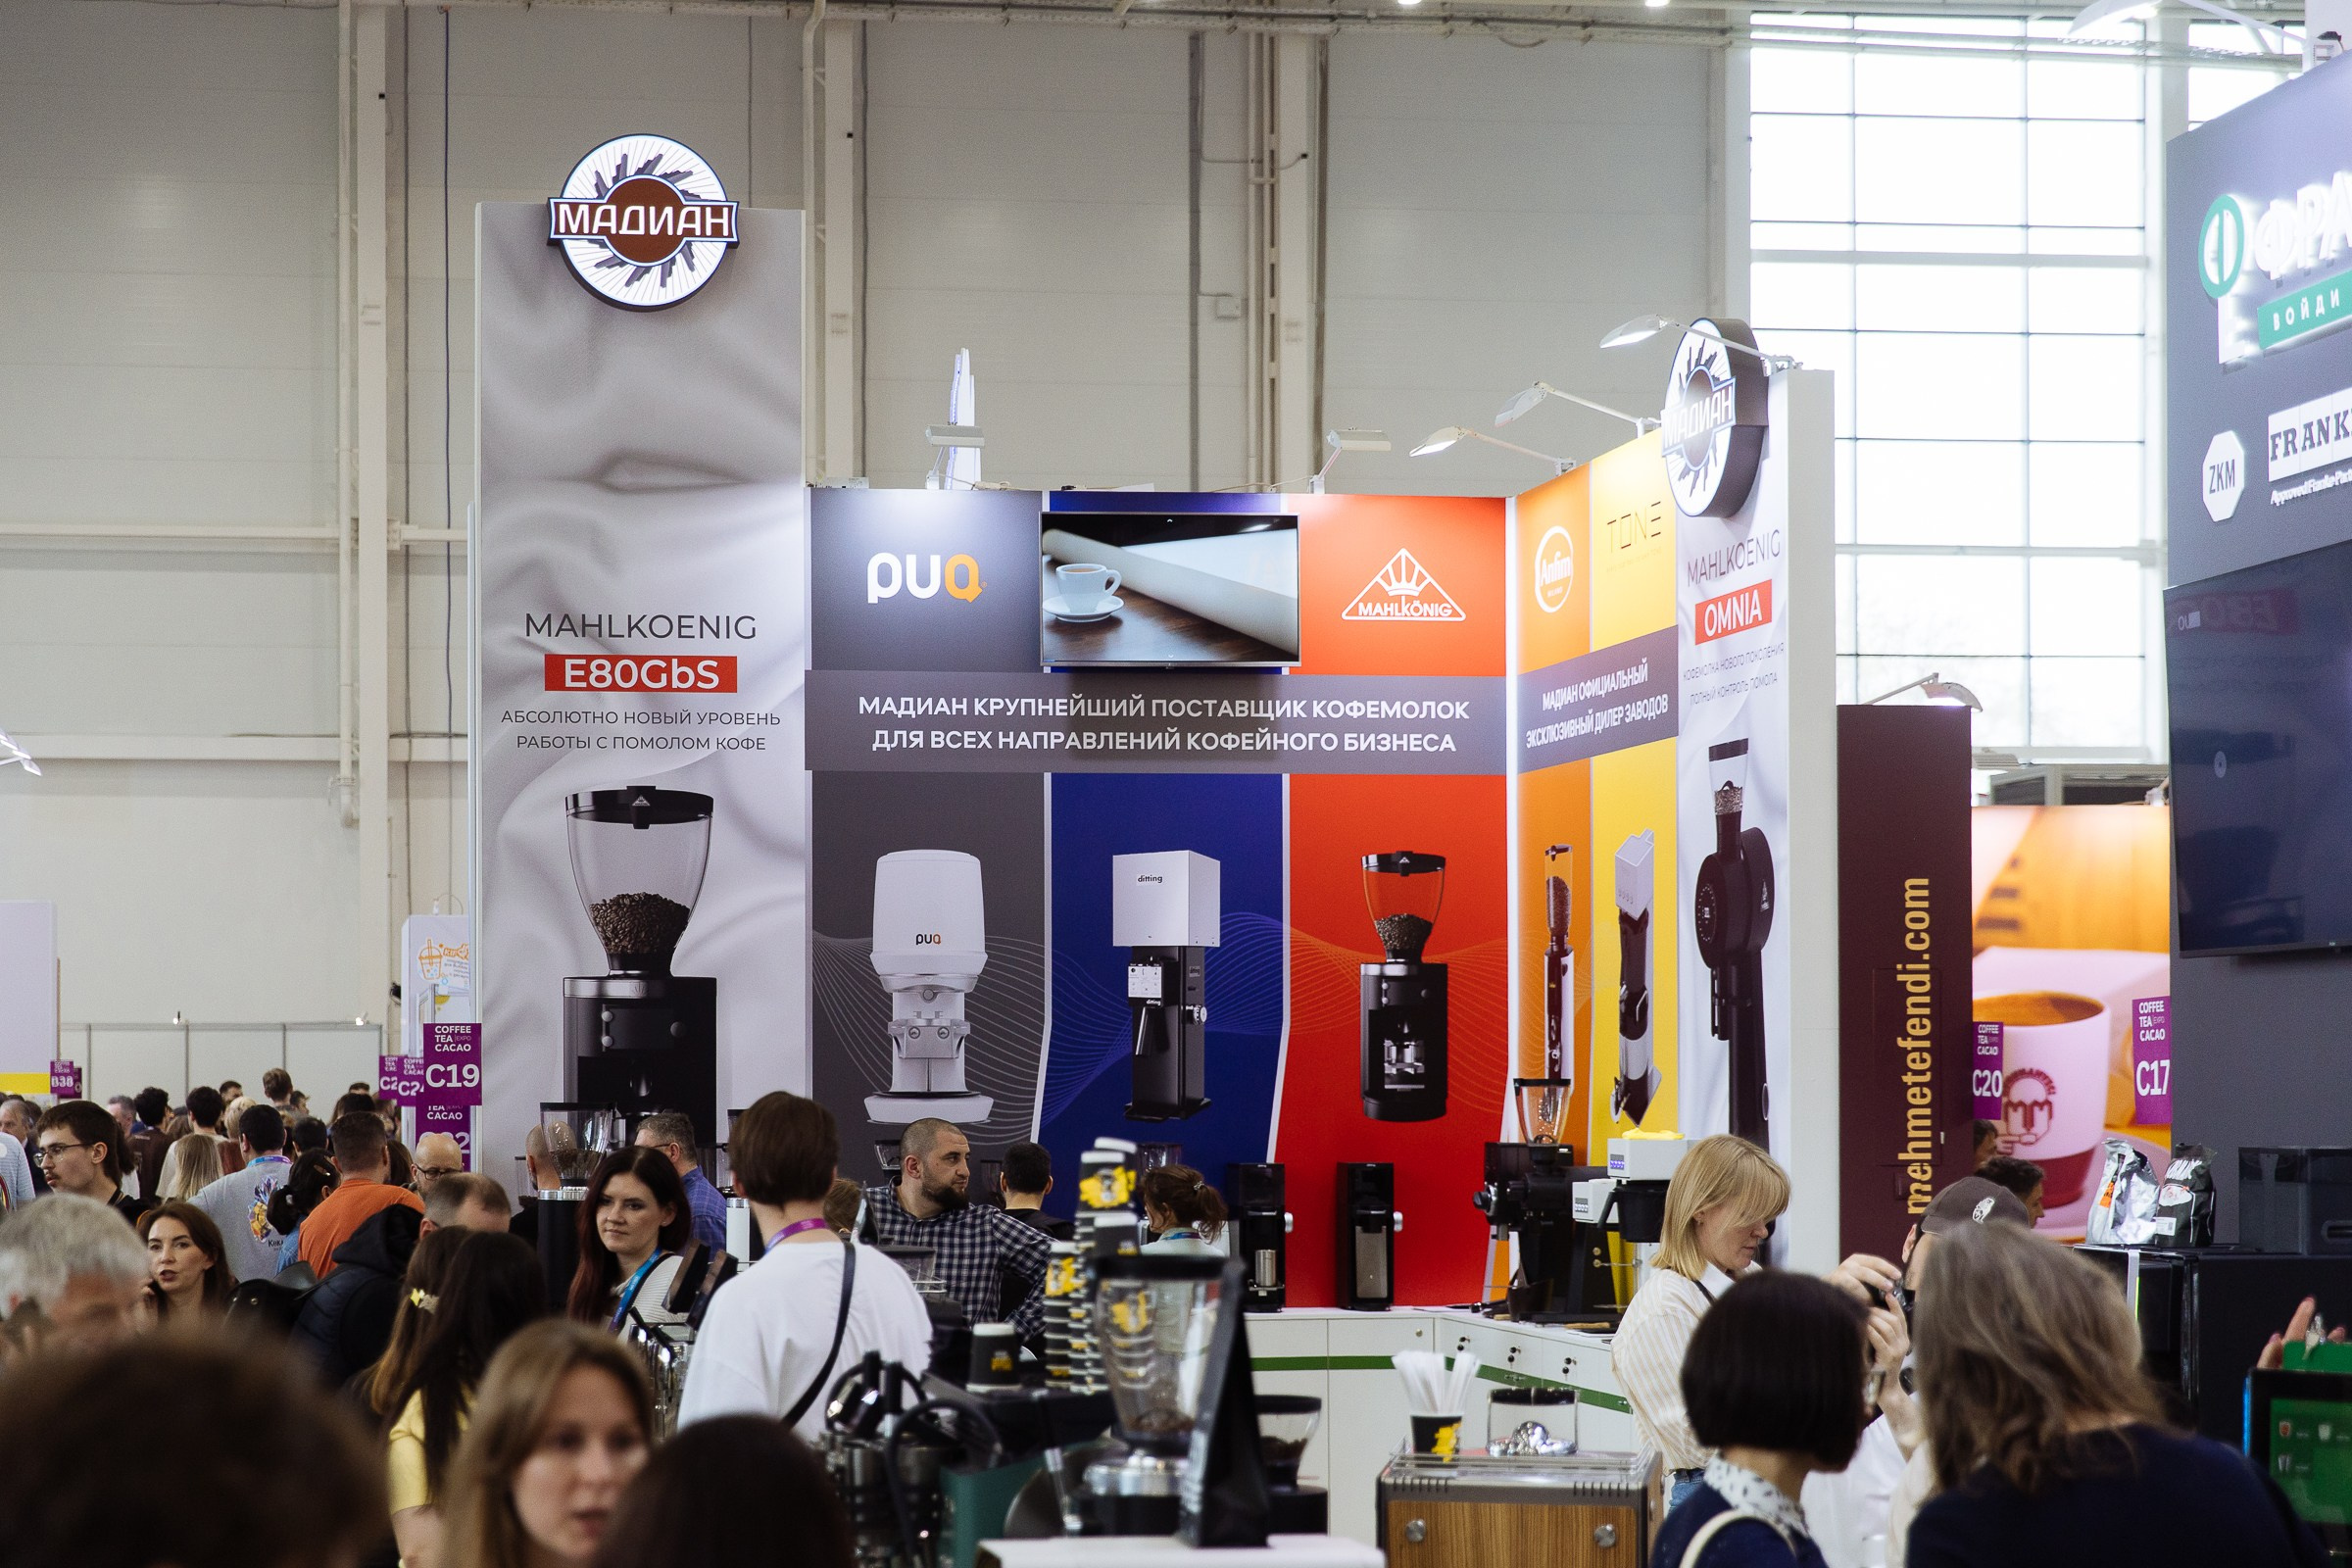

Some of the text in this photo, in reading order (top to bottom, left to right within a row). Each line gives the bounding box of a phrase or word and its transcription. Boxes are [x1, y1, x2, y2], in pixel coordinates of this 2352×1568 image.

[559, 204, 729, 236] МАДИАН
[2273, 288, 2340, 331] ВОЙДИ
[1664, 385, 1733, 447] МАДИАН
[2270, 408, 2352, 463] FRANK
[2209, 459, 2235, 495] ZKM
[2271, 479, 2309, 506] Approved
[2308, 474, 2335, 494] Franke
[1607, 501, 1661, 553] TONE
[1540, 551, 1571, 587] Anfim
[1688, 529, 1781, 587] MAHLKOENIG
[1358, 597, 1453, 616] MAHLKÖNIG
[1704, 590, 1763, 637] OMNIA
[525, 612, 757, 639] MAHLKOENIG
[564, 658, 719, 689] E80GbS
[1543, 657, 1648, 711] МАДИАН ОФИЦИАЛЬНЫЙ
[501, 709, 781, 726] АБСОЛЮТНО НОВЫЙ УРОВЕНЬ
[859, 694, 1470, 720] МАДИАН КРУПНЕЙШИЙ ПОСТАВЩИК КОФЕМОЛОК
[1526, 694, 1669, 749] ЭКСКЛЮЗИВНЫЙ ДИЛЕР ЗАВОДОВ
[516, 735, 766, 751] РАБОТЫ С ПОМОЛОМ КОФЕ
[872, 727, 1457, 753] ДЛЯ ВСЕХ НАПРАВЛЕНИЙ КОФЕЙНОГО БИЗНЕСА
[1138, 874, 1163, 884] ditting
[2138, 1001, 2165, 1013] COFFEE
[435, 1025, 471, 1034] COFFEE
[1978, 1024, 1999, 1034] COFFEE
[2138, 1015, 2152, 1028] TEA
[2139, 1029, 2166, 1042] CACAO
[1896, 878, 1933, 1214] mehmetefendi.com
[1977, 1046, 1998, 1055] CACAO
[1978, 1035, 1988, 1045] TEA
[425, 1063, 480, 1088] C19
[1973, 1069, 2002, 1098] C20
[2136, 1059, 2171, 1097] C17
[427, 1111, 463, 1120] CACAO
